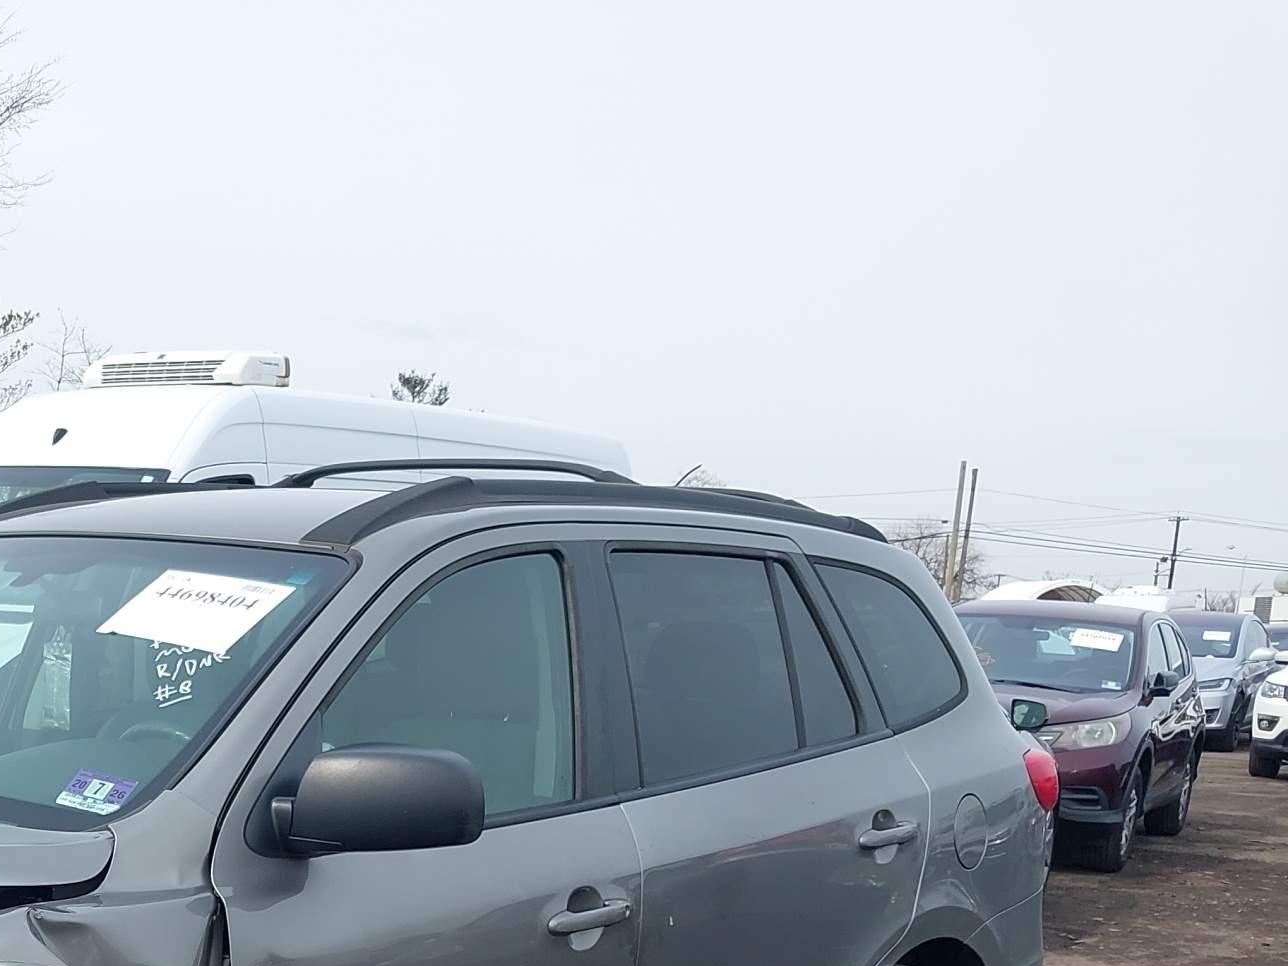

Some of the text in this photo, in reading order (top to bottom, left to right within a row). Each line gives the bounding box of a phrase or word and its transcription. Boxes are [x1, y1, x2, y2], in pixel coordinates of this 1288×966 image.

[156, 586, 259, 610] 44698404
[71, 779, 127, 799] 20 7 26
